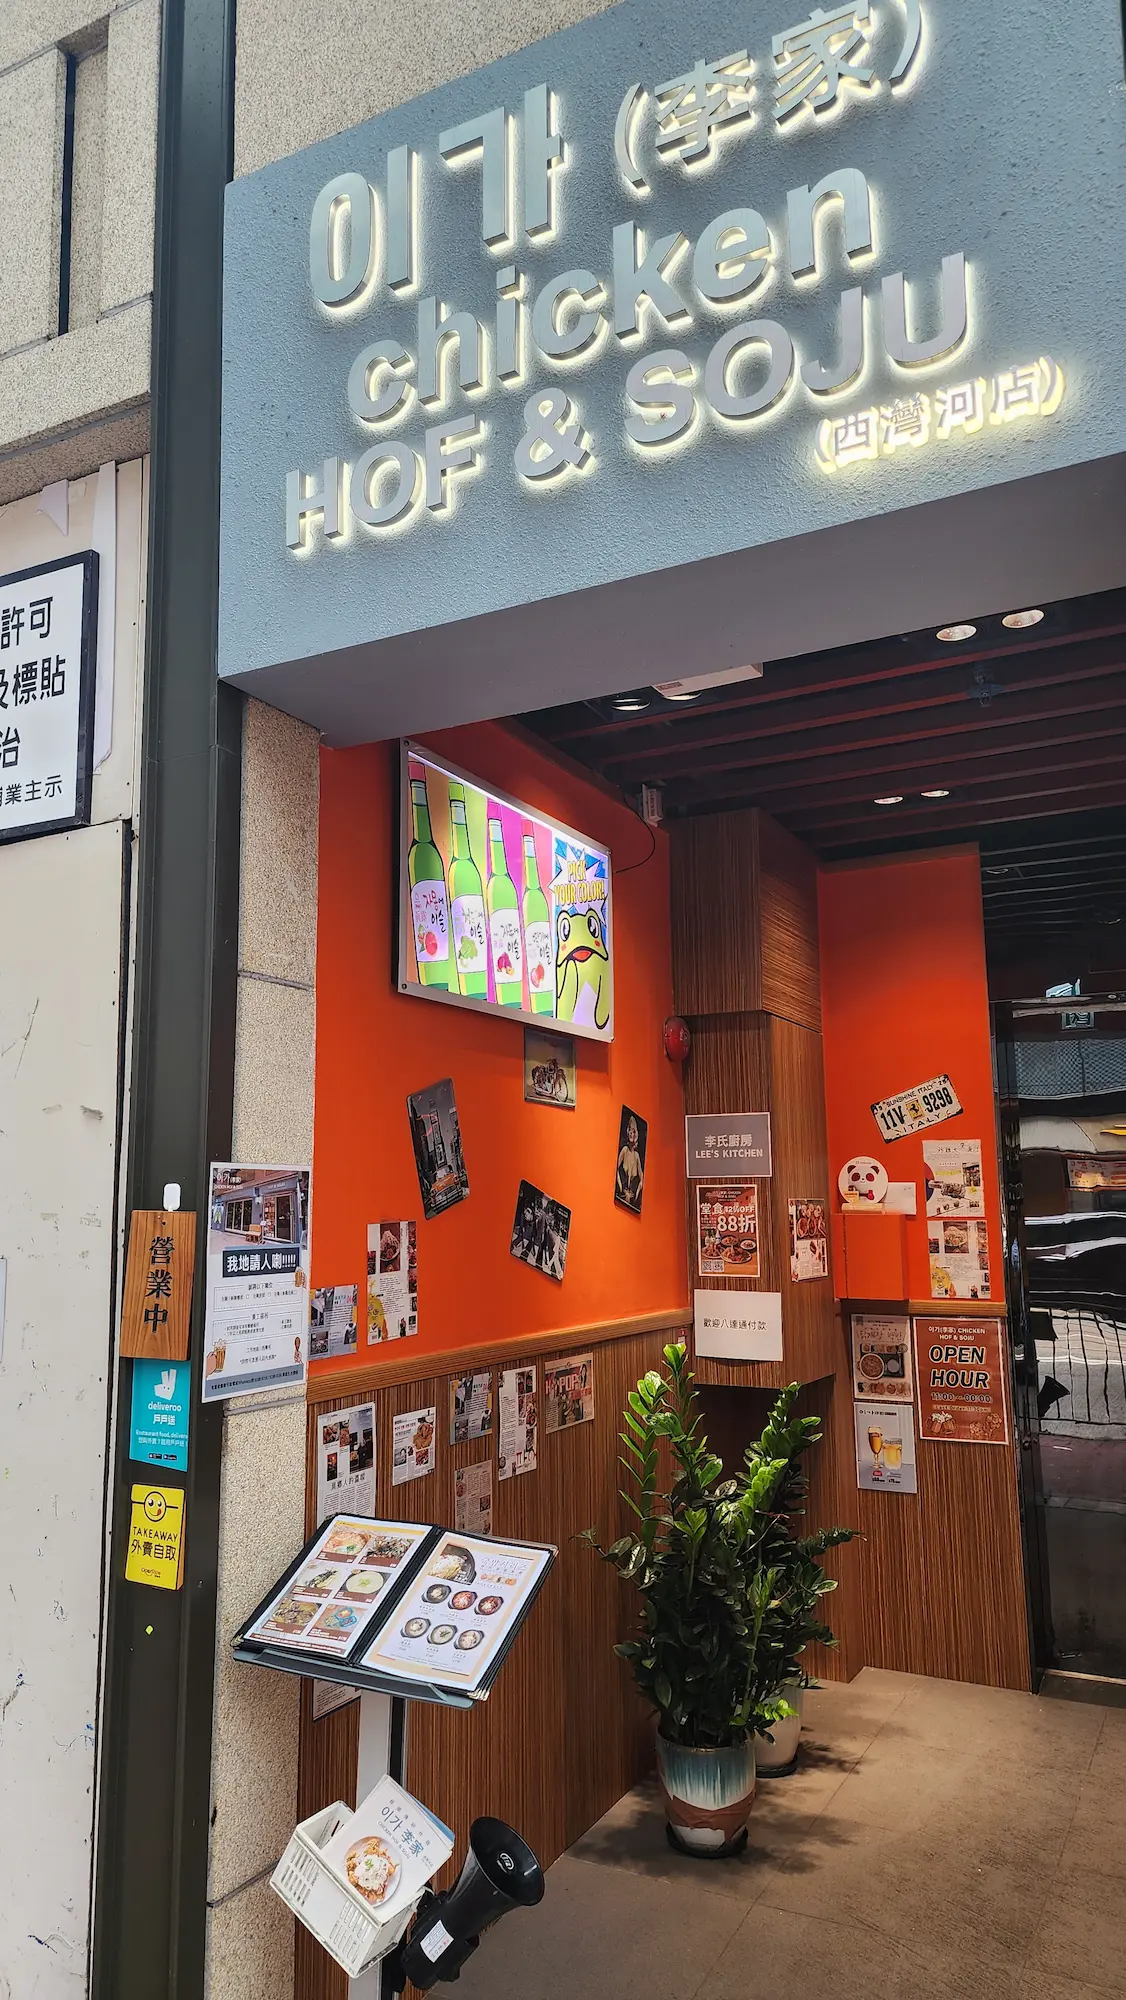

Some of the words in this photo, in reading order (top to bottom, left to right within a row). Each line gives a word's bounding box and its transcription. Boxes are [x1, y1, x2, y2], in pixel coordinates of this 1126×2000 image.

[310, 83, 564, 309] 이가
[616, 0, 925, 191] (李家)
[348, 167, 878, 425] chicken
[285, 416, 480, 549] HOF
[516, 387, 594, 481] &
[625, 252, 970, 449] SOJU
[814, 354, 1066, 470] (西灣河店)
[1, 596, 53, 649] 許可
[567, 860, 586, 882] PICK
[554, 883, 577, 907] YOUR
[577, 880, 605, 904] COLOR!
[886, 1090, 916, 1108] SUNSHINE
[917, 1084, 934, 1094] ITALY
[922, 1087, 953, 1113] 9298
[903, 1113, 941, 1133] ITALY
[704, 1133, 753, 1148] 李氏廚房
[695, 1149, 720, 1159] LEE'S
[722, 1148, 764, 1158] KITCHEN
[700, 1202, 724, 1215] 堂食
[717, 1214, 756, 1234] 88折
[143, 1236, 175, 1335] 營業中
[930, 1345, 985, 1365] OPEN
[930, 1368, 991, 1390] HOUR
[148, 1401, 182, 1412] deliveroo
[153, 1414, 176, 1426] 戶戶送
[133, 1526, 178, 1542] TAKEAWAY
[131, 1539, 177, 1561] 外賣自取
[381, 1806, 403, 1832] 이가
[401, 1828, 424, 1858] 李家
